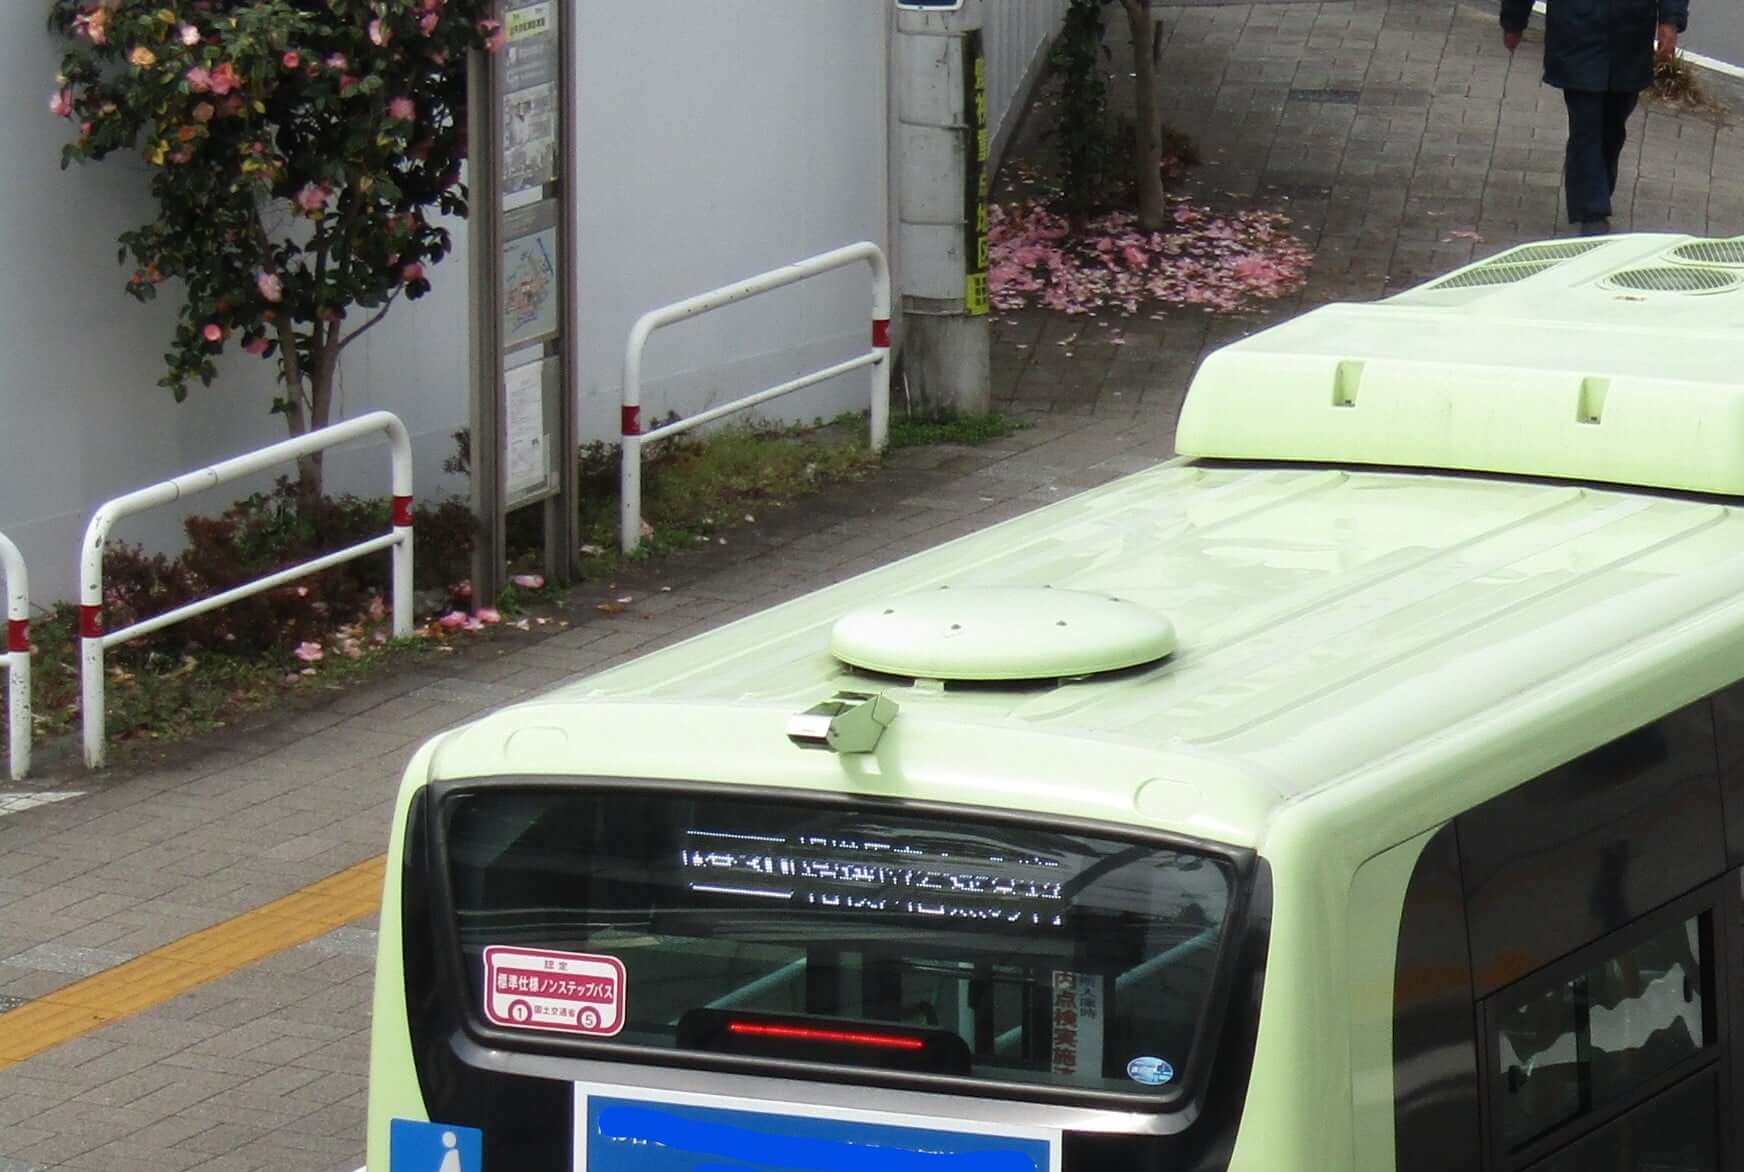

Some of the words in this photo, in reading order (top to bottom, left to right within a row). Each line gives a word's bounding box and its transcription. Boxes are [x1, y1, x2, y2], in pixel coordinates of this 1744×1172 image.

[497, 972, 613, 999] 標準仕様ノンステップバス
[534, 1004, 576, 1019] 国土交通省
